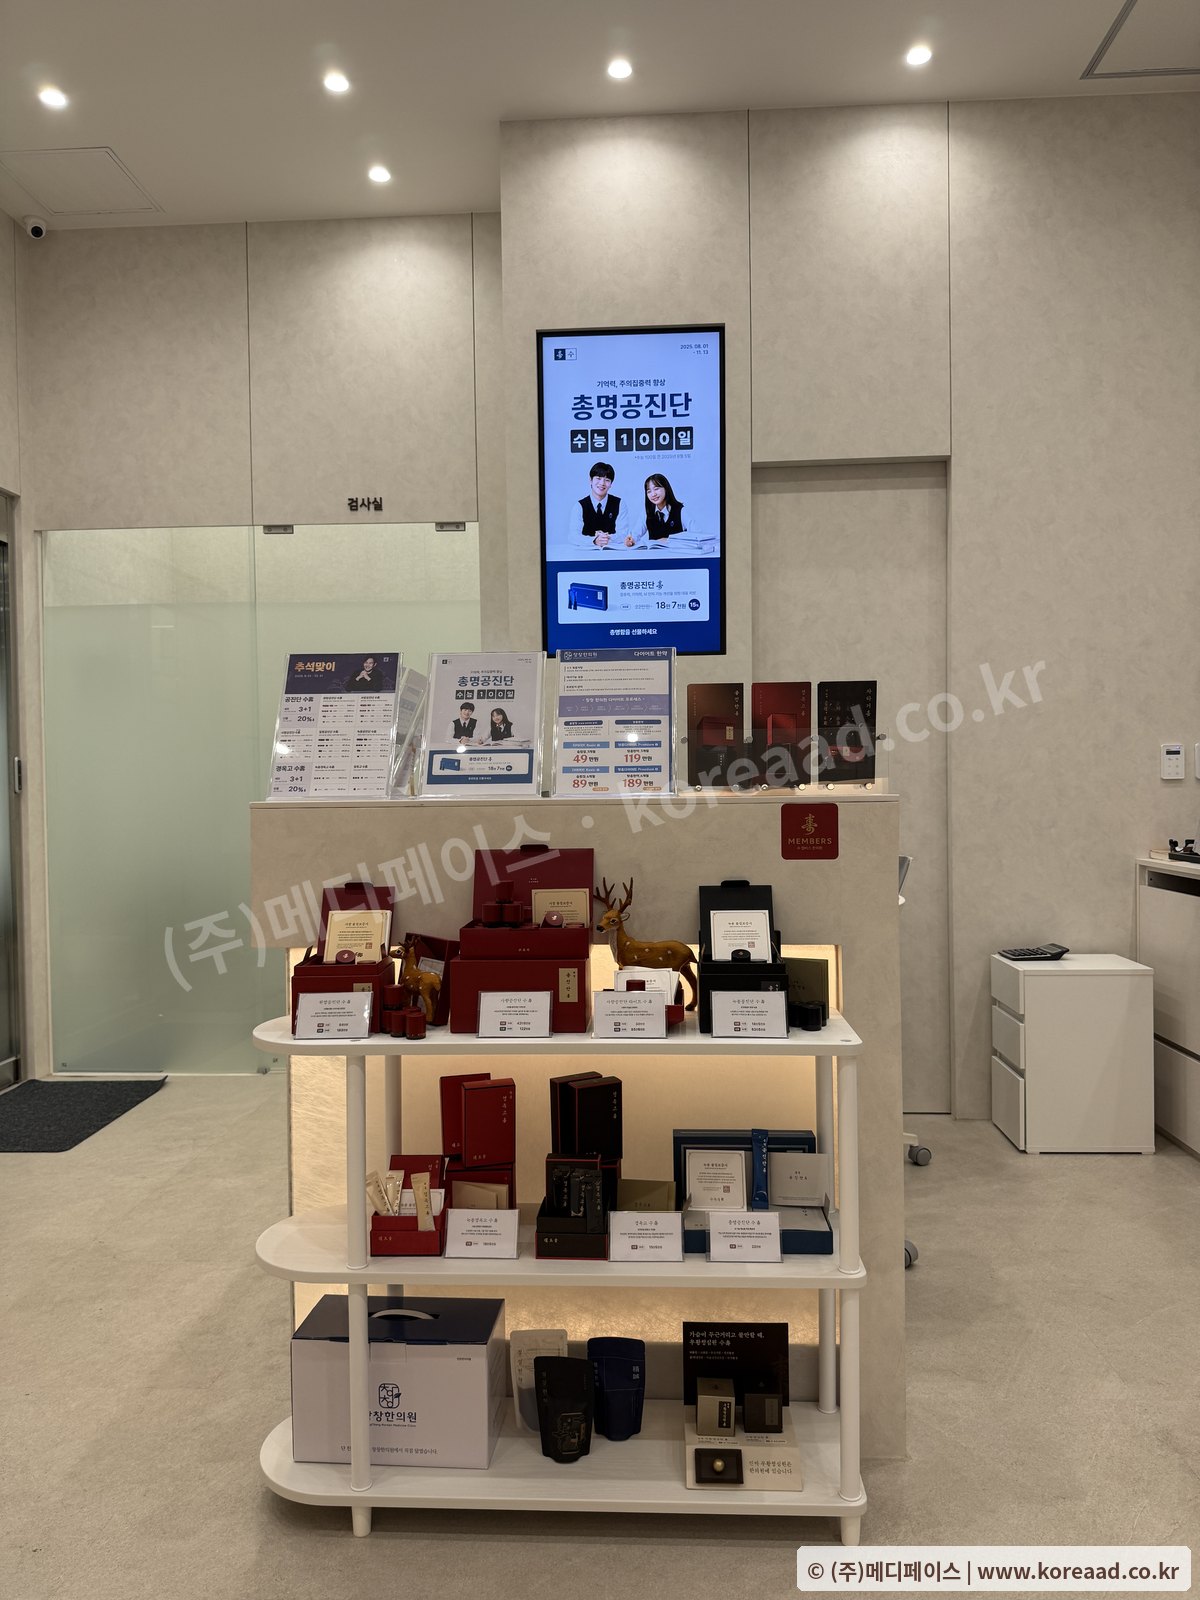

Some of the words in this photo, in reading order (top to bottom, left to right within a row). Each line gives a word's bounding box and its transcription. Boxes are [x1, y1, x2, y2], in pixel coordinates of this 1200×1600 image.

[571, 392, 692, 420] 총명공진단
[571, 431, 608, 450] 수능
[618, 429, 692, 449] 100일
[347, 496, 383, 511] 검사실
[620, 581, 654, 590] 총명공진단
[294, 661, 336, 672] 추석맞이
[457, 675, 514, 687] 총명공진단
[456, 689, 474, 700] 수능
[573, 754, 588, 763] 49
[624, 753, 641, 763] 119
[572, 779, 587, 788] 89
[623, 778, 642, 788] 189
